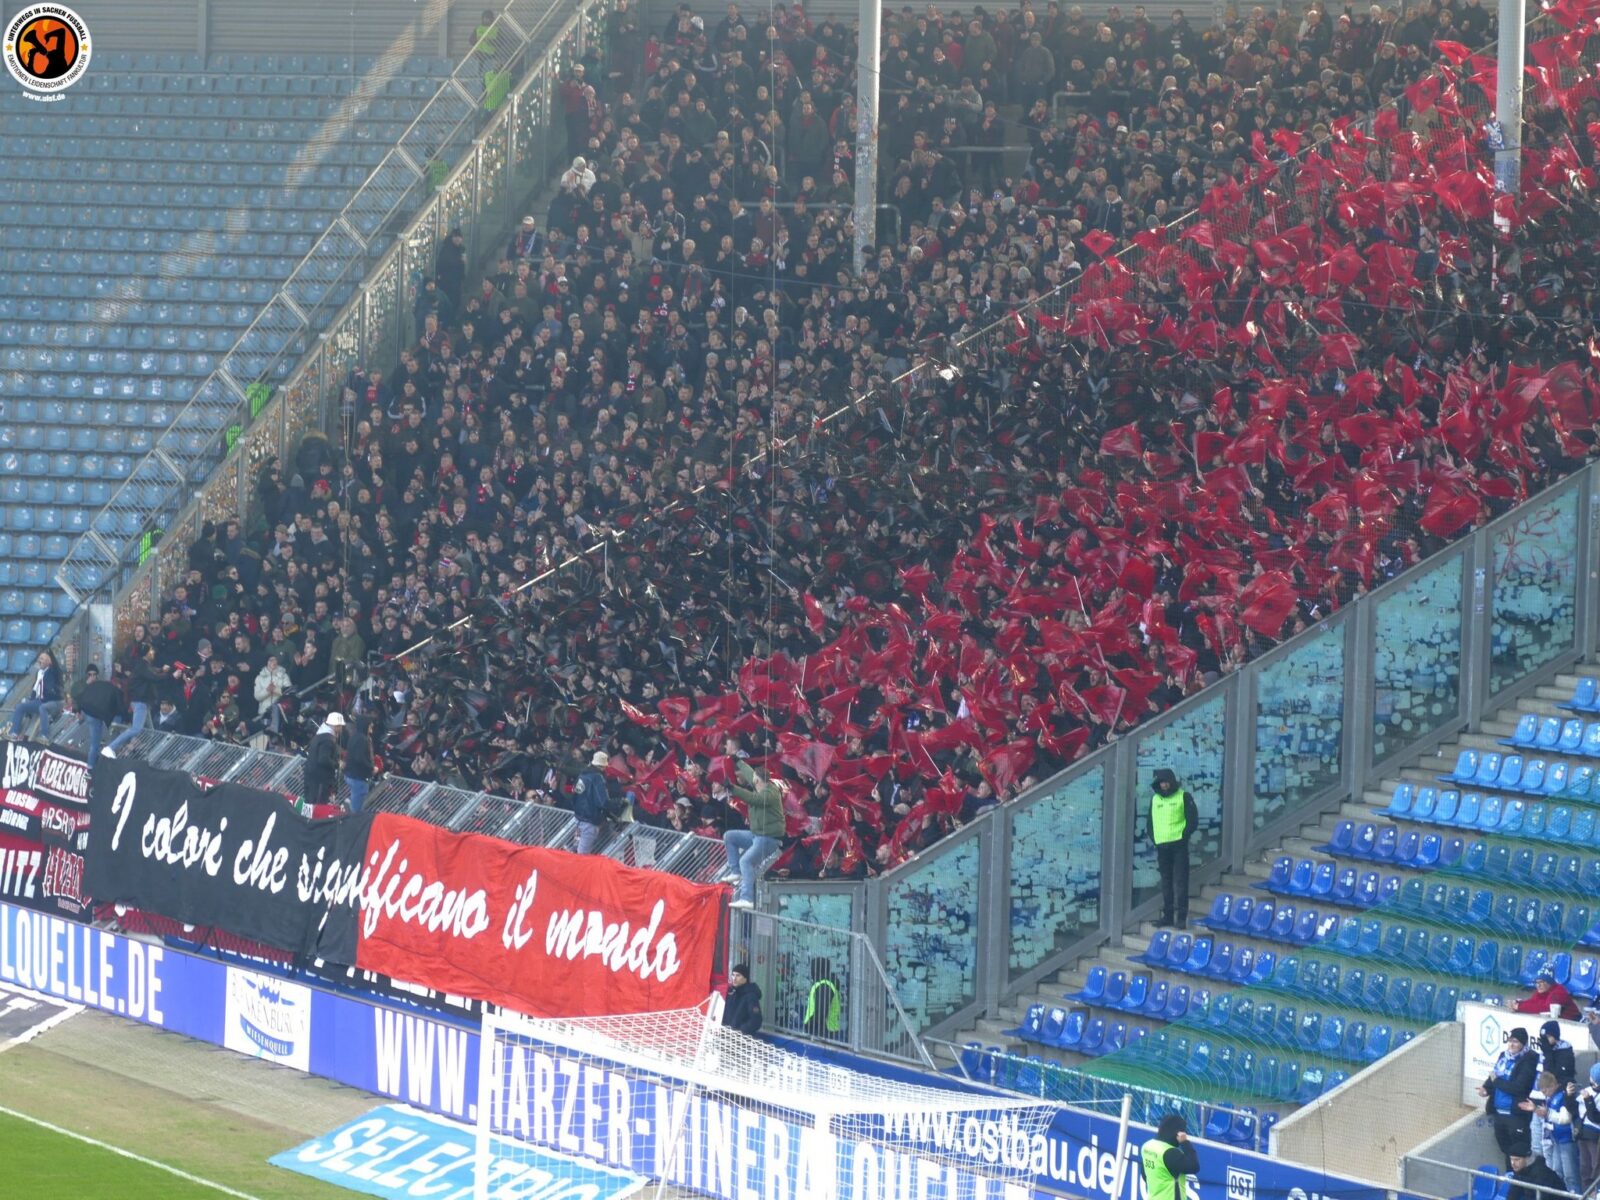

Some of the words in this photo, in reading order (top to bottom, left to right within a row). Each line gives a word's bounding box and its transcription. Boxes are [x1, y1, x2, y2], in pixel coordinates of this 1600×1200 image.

[142, 800, 227, 876] colori
[233, 811, 288, 894] che
[296, 839, 489, 940] significano
[502, 868, 537, 950] il
[545, 899, 681, 983] mondo
[1230, 1174, 1252, 1198] OST
